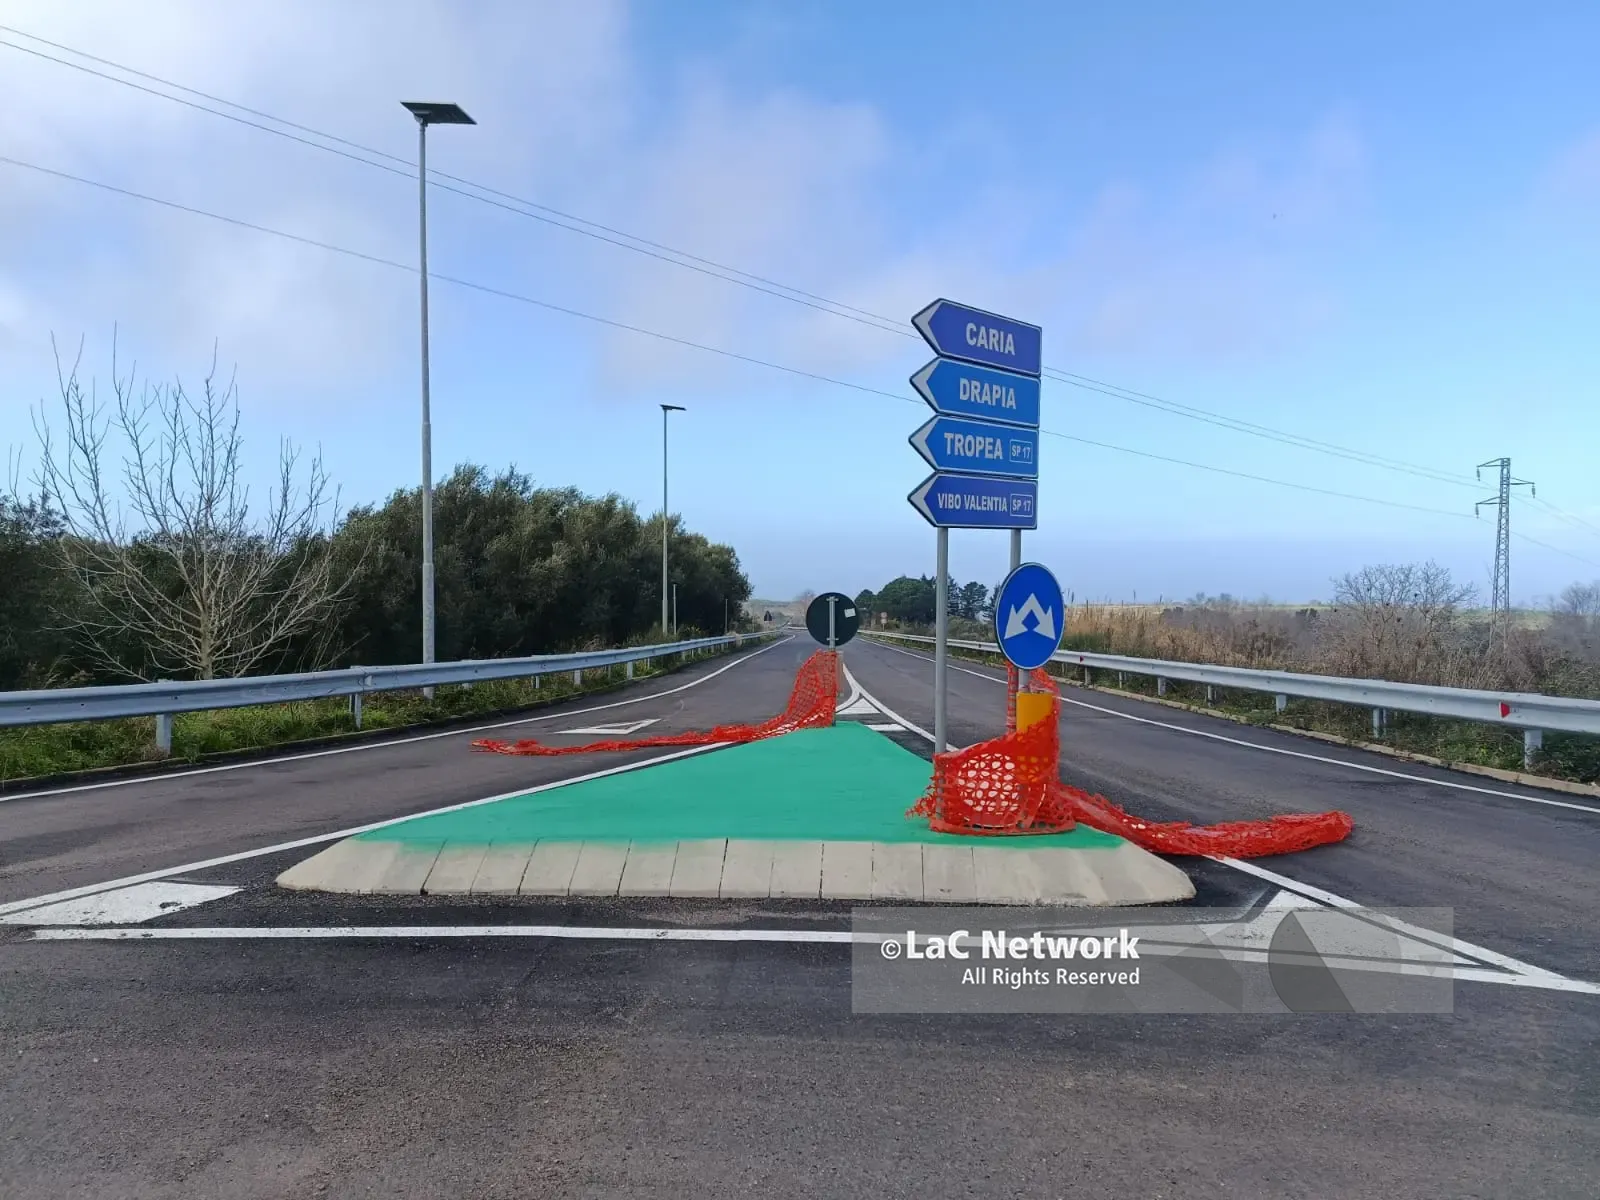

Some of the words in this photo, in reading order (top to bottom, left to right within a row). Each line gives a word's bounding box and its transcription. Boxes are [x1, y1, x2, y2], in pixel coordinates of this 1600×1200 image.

[965, 322, 1015, 355] CARIA
[959, 378, 1016, 409] DRAPIA
[944, 432, 1003, 459] TROPEA
[1011, 444, 1021, 457] SP
[1022, 446, 1031, 459] 17
[937, 492, 961, 509] VIBO
[963, 494, 1008, 512] VALENTIA
[1012, 499, 1022, 511] SP
[1023, 500, 1032, 512] 17
